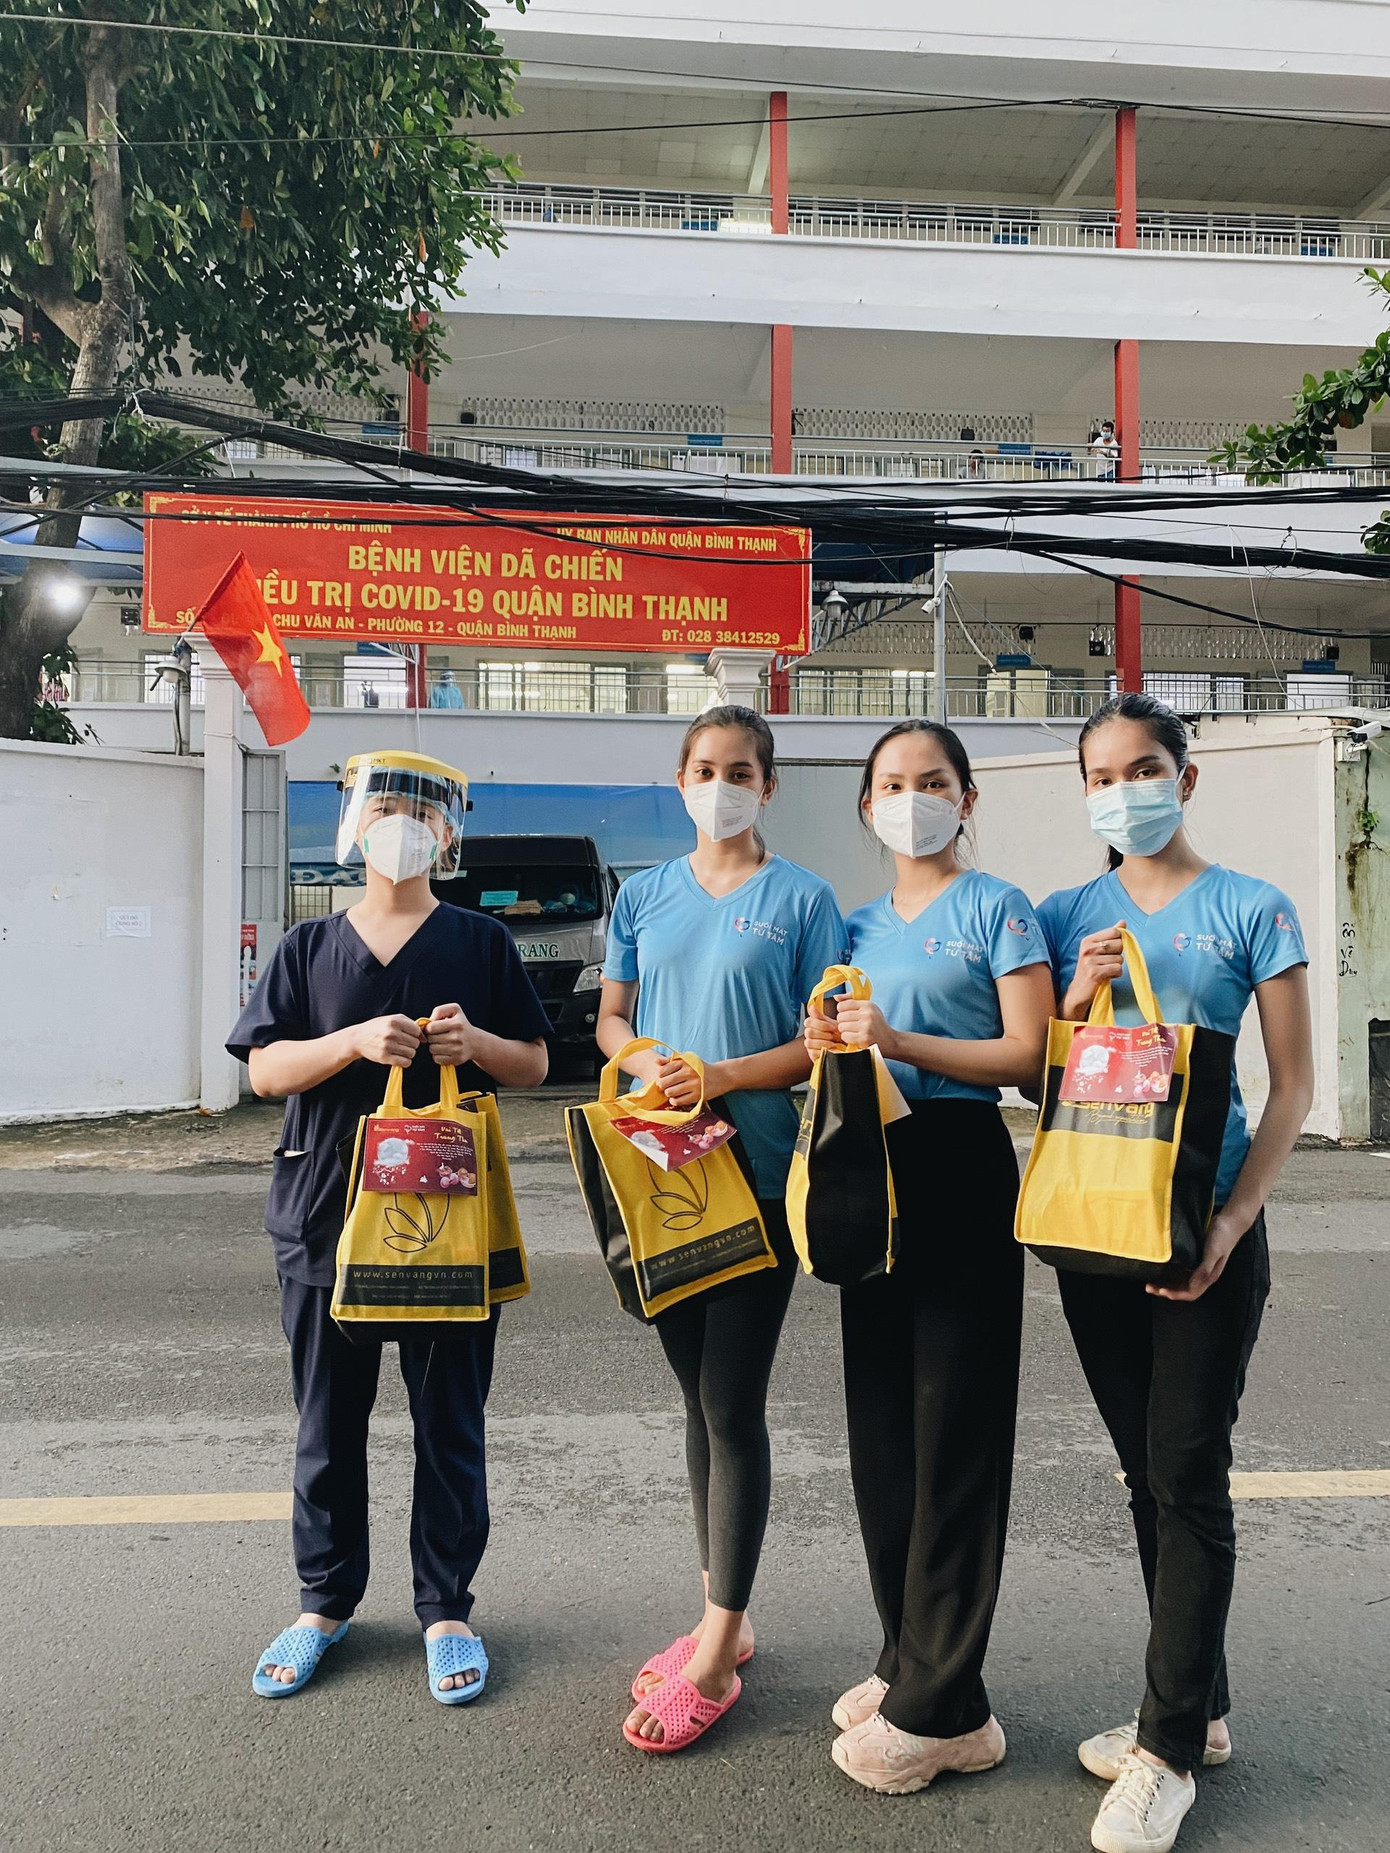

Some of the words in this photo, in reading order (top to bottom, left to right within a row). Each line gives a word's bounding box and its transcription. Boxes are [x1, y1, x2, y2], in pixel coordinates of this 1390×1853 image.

[576, 527, 602, 543] BAN
[605, 528, 638, 545] NHÂN
[641, 528, 667, 546] DÂN
[669, 530, 702, 550] QUẬN
[705, 532, 735, 549] BÌNH
[736, 536, 778, 553] THẠNH
[348, 540, 422, 577] BỆNH
[430, 544, 492, 581] VIỆN
[501, 547, 537, 579] DÃ
[544, 548, 623, 582] CHIẾN
[255, 568, 298, 605] ỀU
[306, 580, 351, 613] TRỊ
[360, 582, 484, 613] COVID-19
[492, 585, 563, 621] QUẬN
[572, 586, 634, 619] BÌNH
[641, 595, 728, 626] THẠNH
[176, 606, 196, 625] SỐ
[272, 613, 300, 628] CHU
[304, 612, 332, 629] VĂN
[335, 616, 355, 630] AN
[367, 616, 423, 633] PHƯỜNG
[427, 620, 444, 633] 12
[456, 619, 493, 637] QUẬN
[496, 620, 529, 637] BÌNH
[532, 624, 577, 641] THẠNH
[661, 629, 684, 642] ĐT:
[687, 630, 712, 643] 028
[715, 630, 781, 645] 38412529
